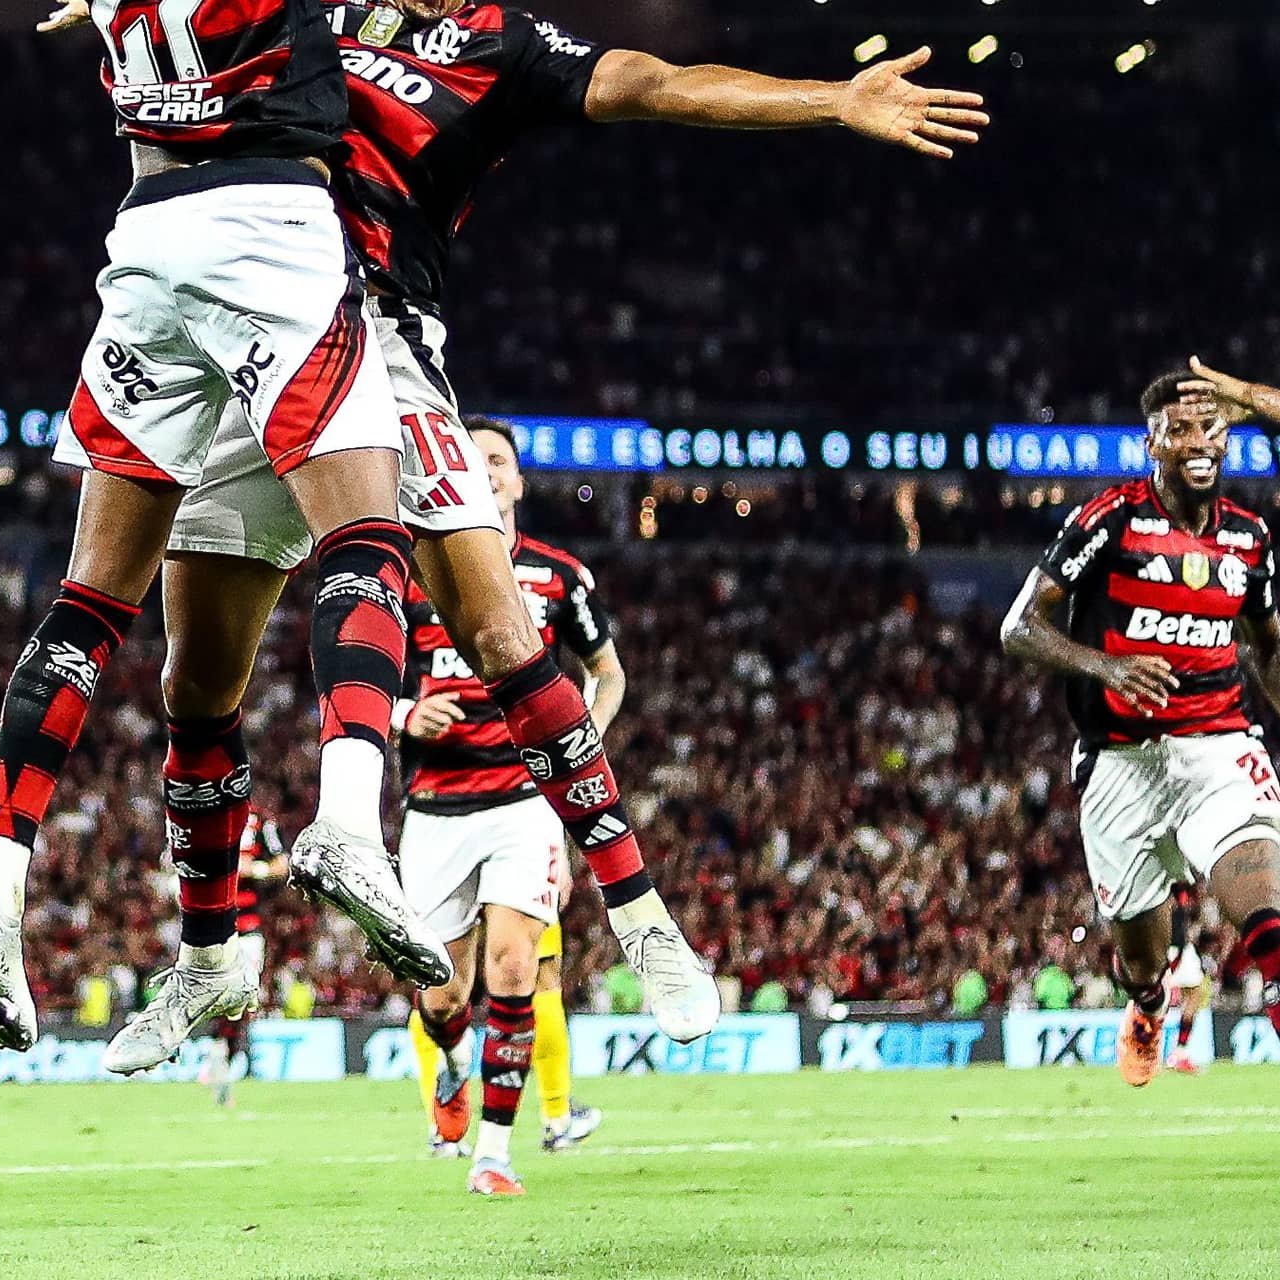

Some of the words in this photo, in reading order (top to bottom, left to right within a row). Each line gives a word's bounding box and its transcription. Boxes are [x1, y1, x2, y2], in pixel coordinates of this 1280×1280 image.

[136, 96, 223, 121] CARD
[401, 412, 469, 478] 16
[611, 426, 807, 470] ESCOLHA
[821, 430, 851, 469] O
[867, 430, 948, 471] SEU
[818, 1021, 985, 1070] 1XBET
